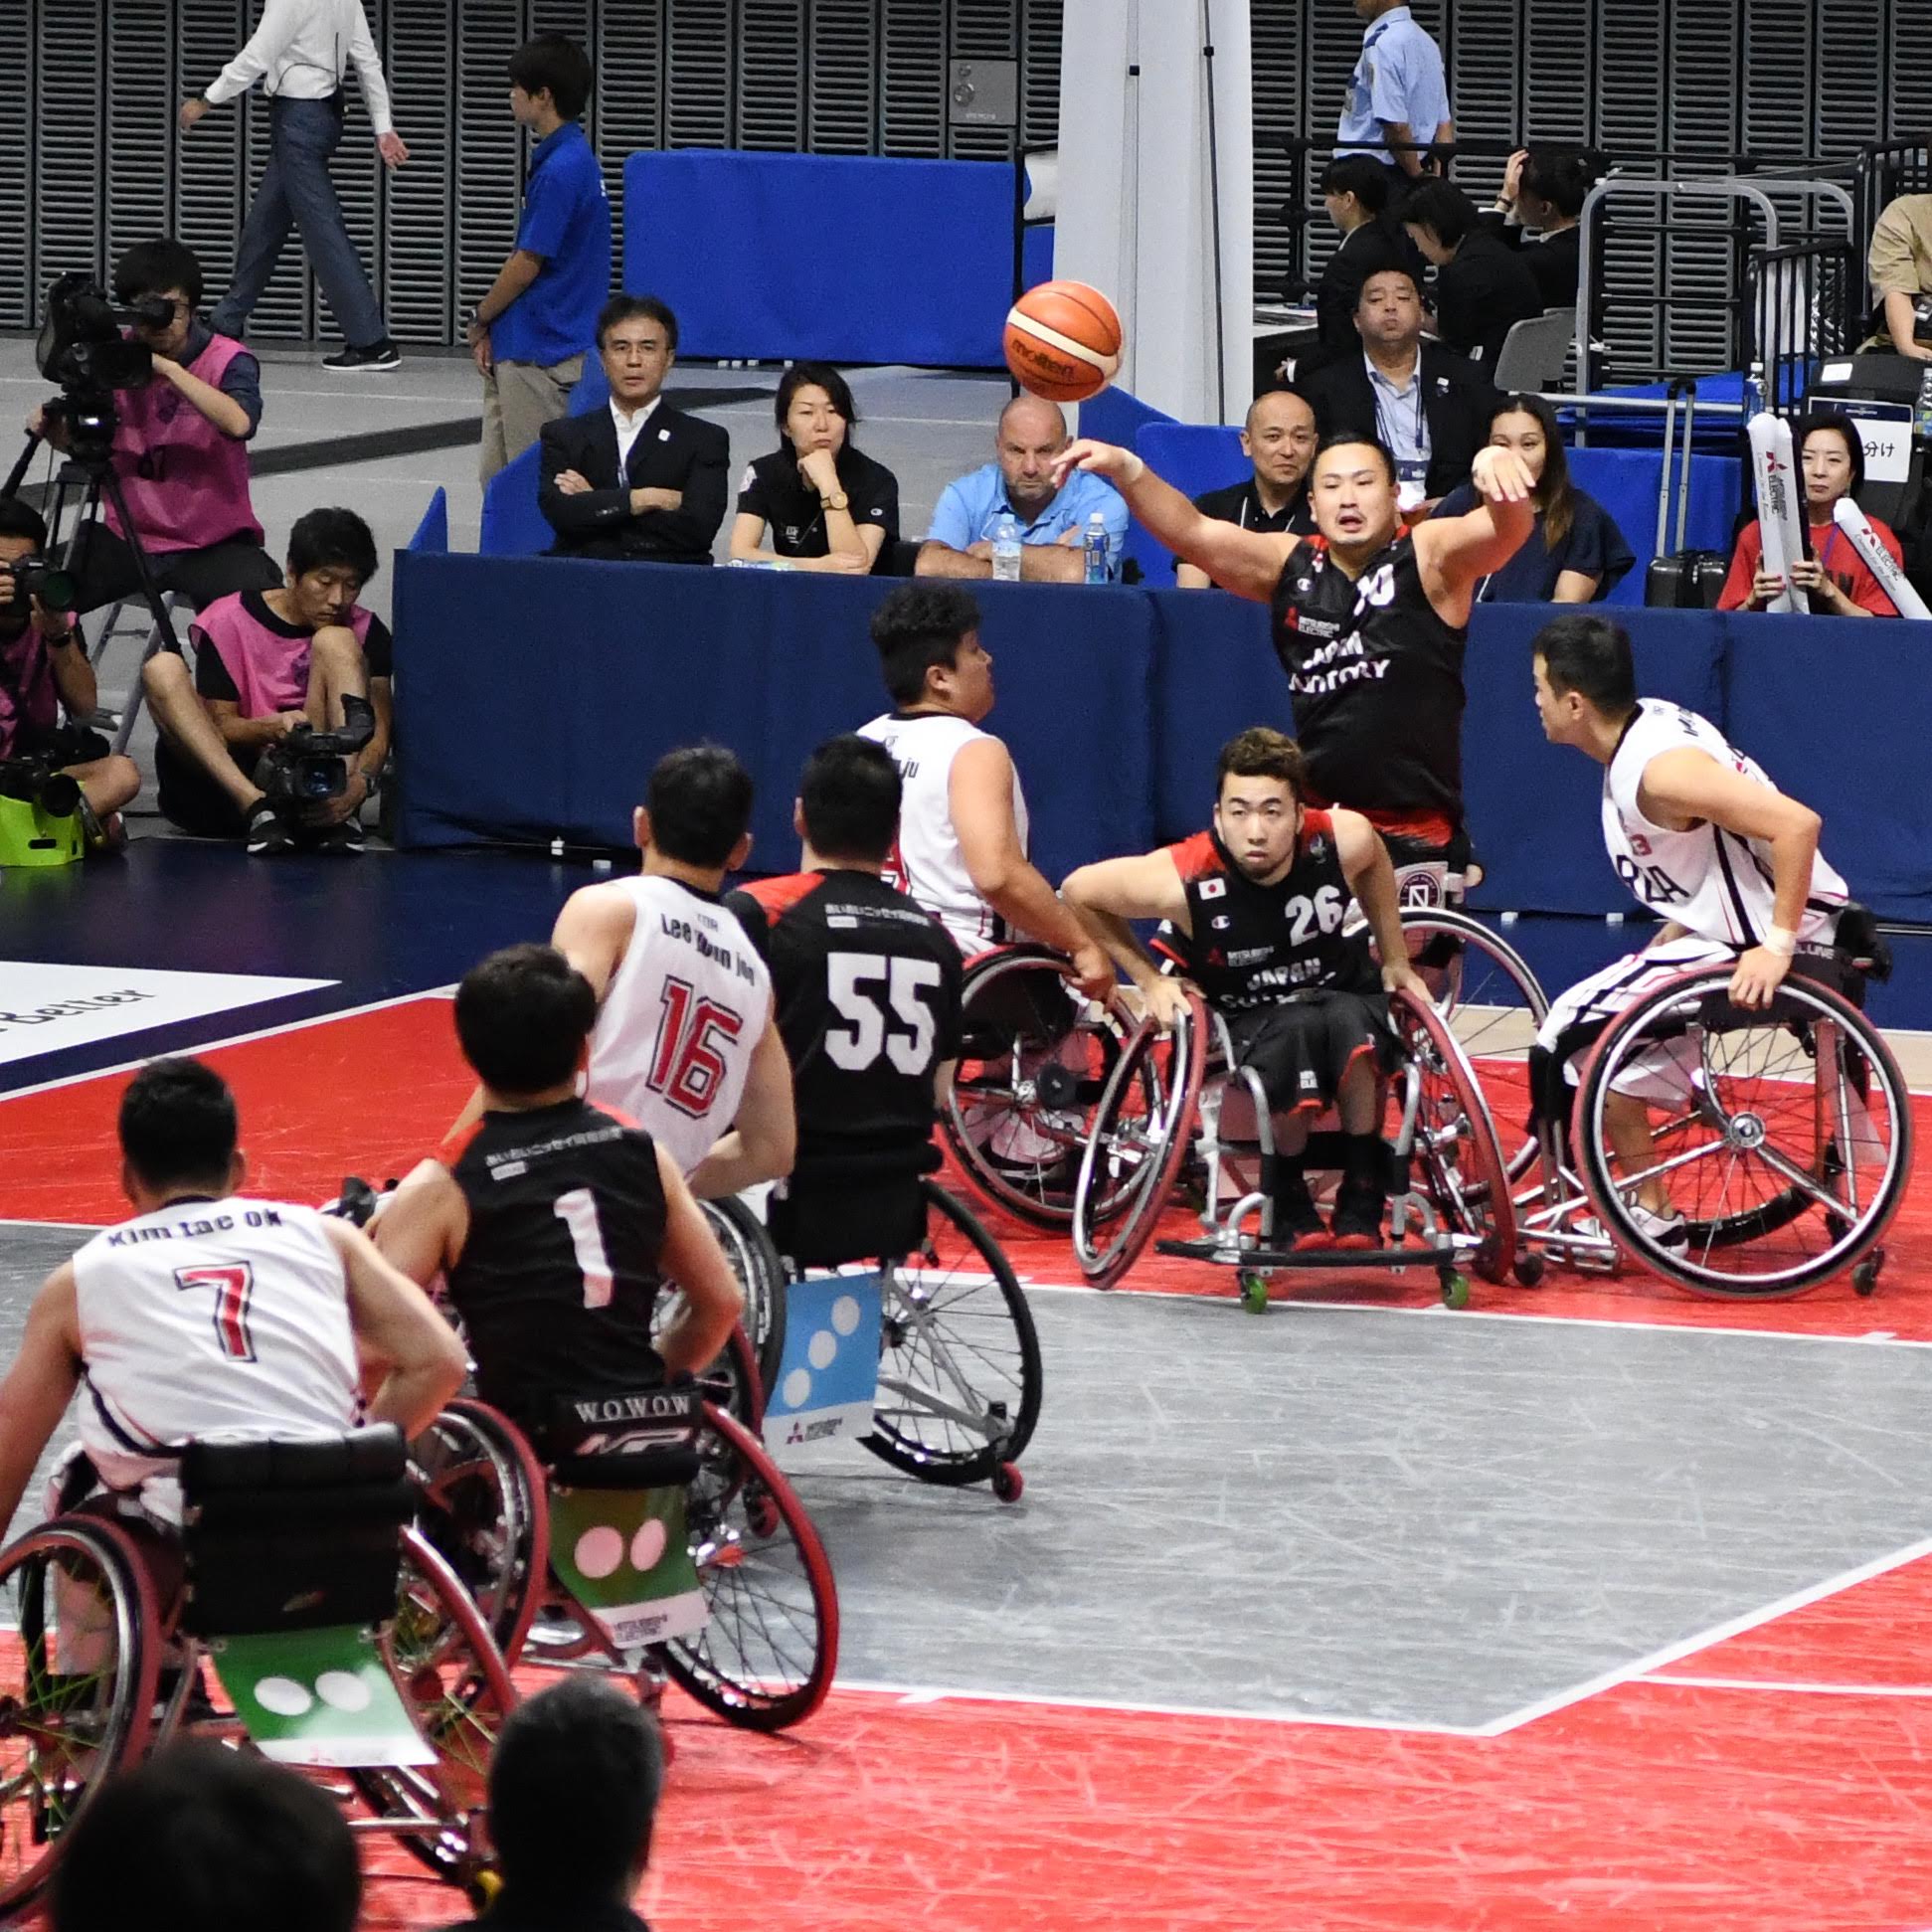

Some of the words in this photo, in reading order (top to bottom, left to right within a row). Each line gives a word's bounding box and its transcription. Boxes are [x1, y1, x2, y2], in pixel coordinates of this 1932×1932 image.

[1769, 474, 1781, 514] ELECTRIC
[660, 913, 692, 944] Lee
[1285, 884, 1343, 946] 26
[1247, 958, 1320, 991] JAPAN
[0, 988, 157, 1025] Better
[824, 952, 942, 1075] 55
[645, 973, 744, 1120] 16
[553, 1187, 615, 1309] 1
[174, 1260, 258, 1363] 7
[574, 1395, 691, 1424] WOWOW
